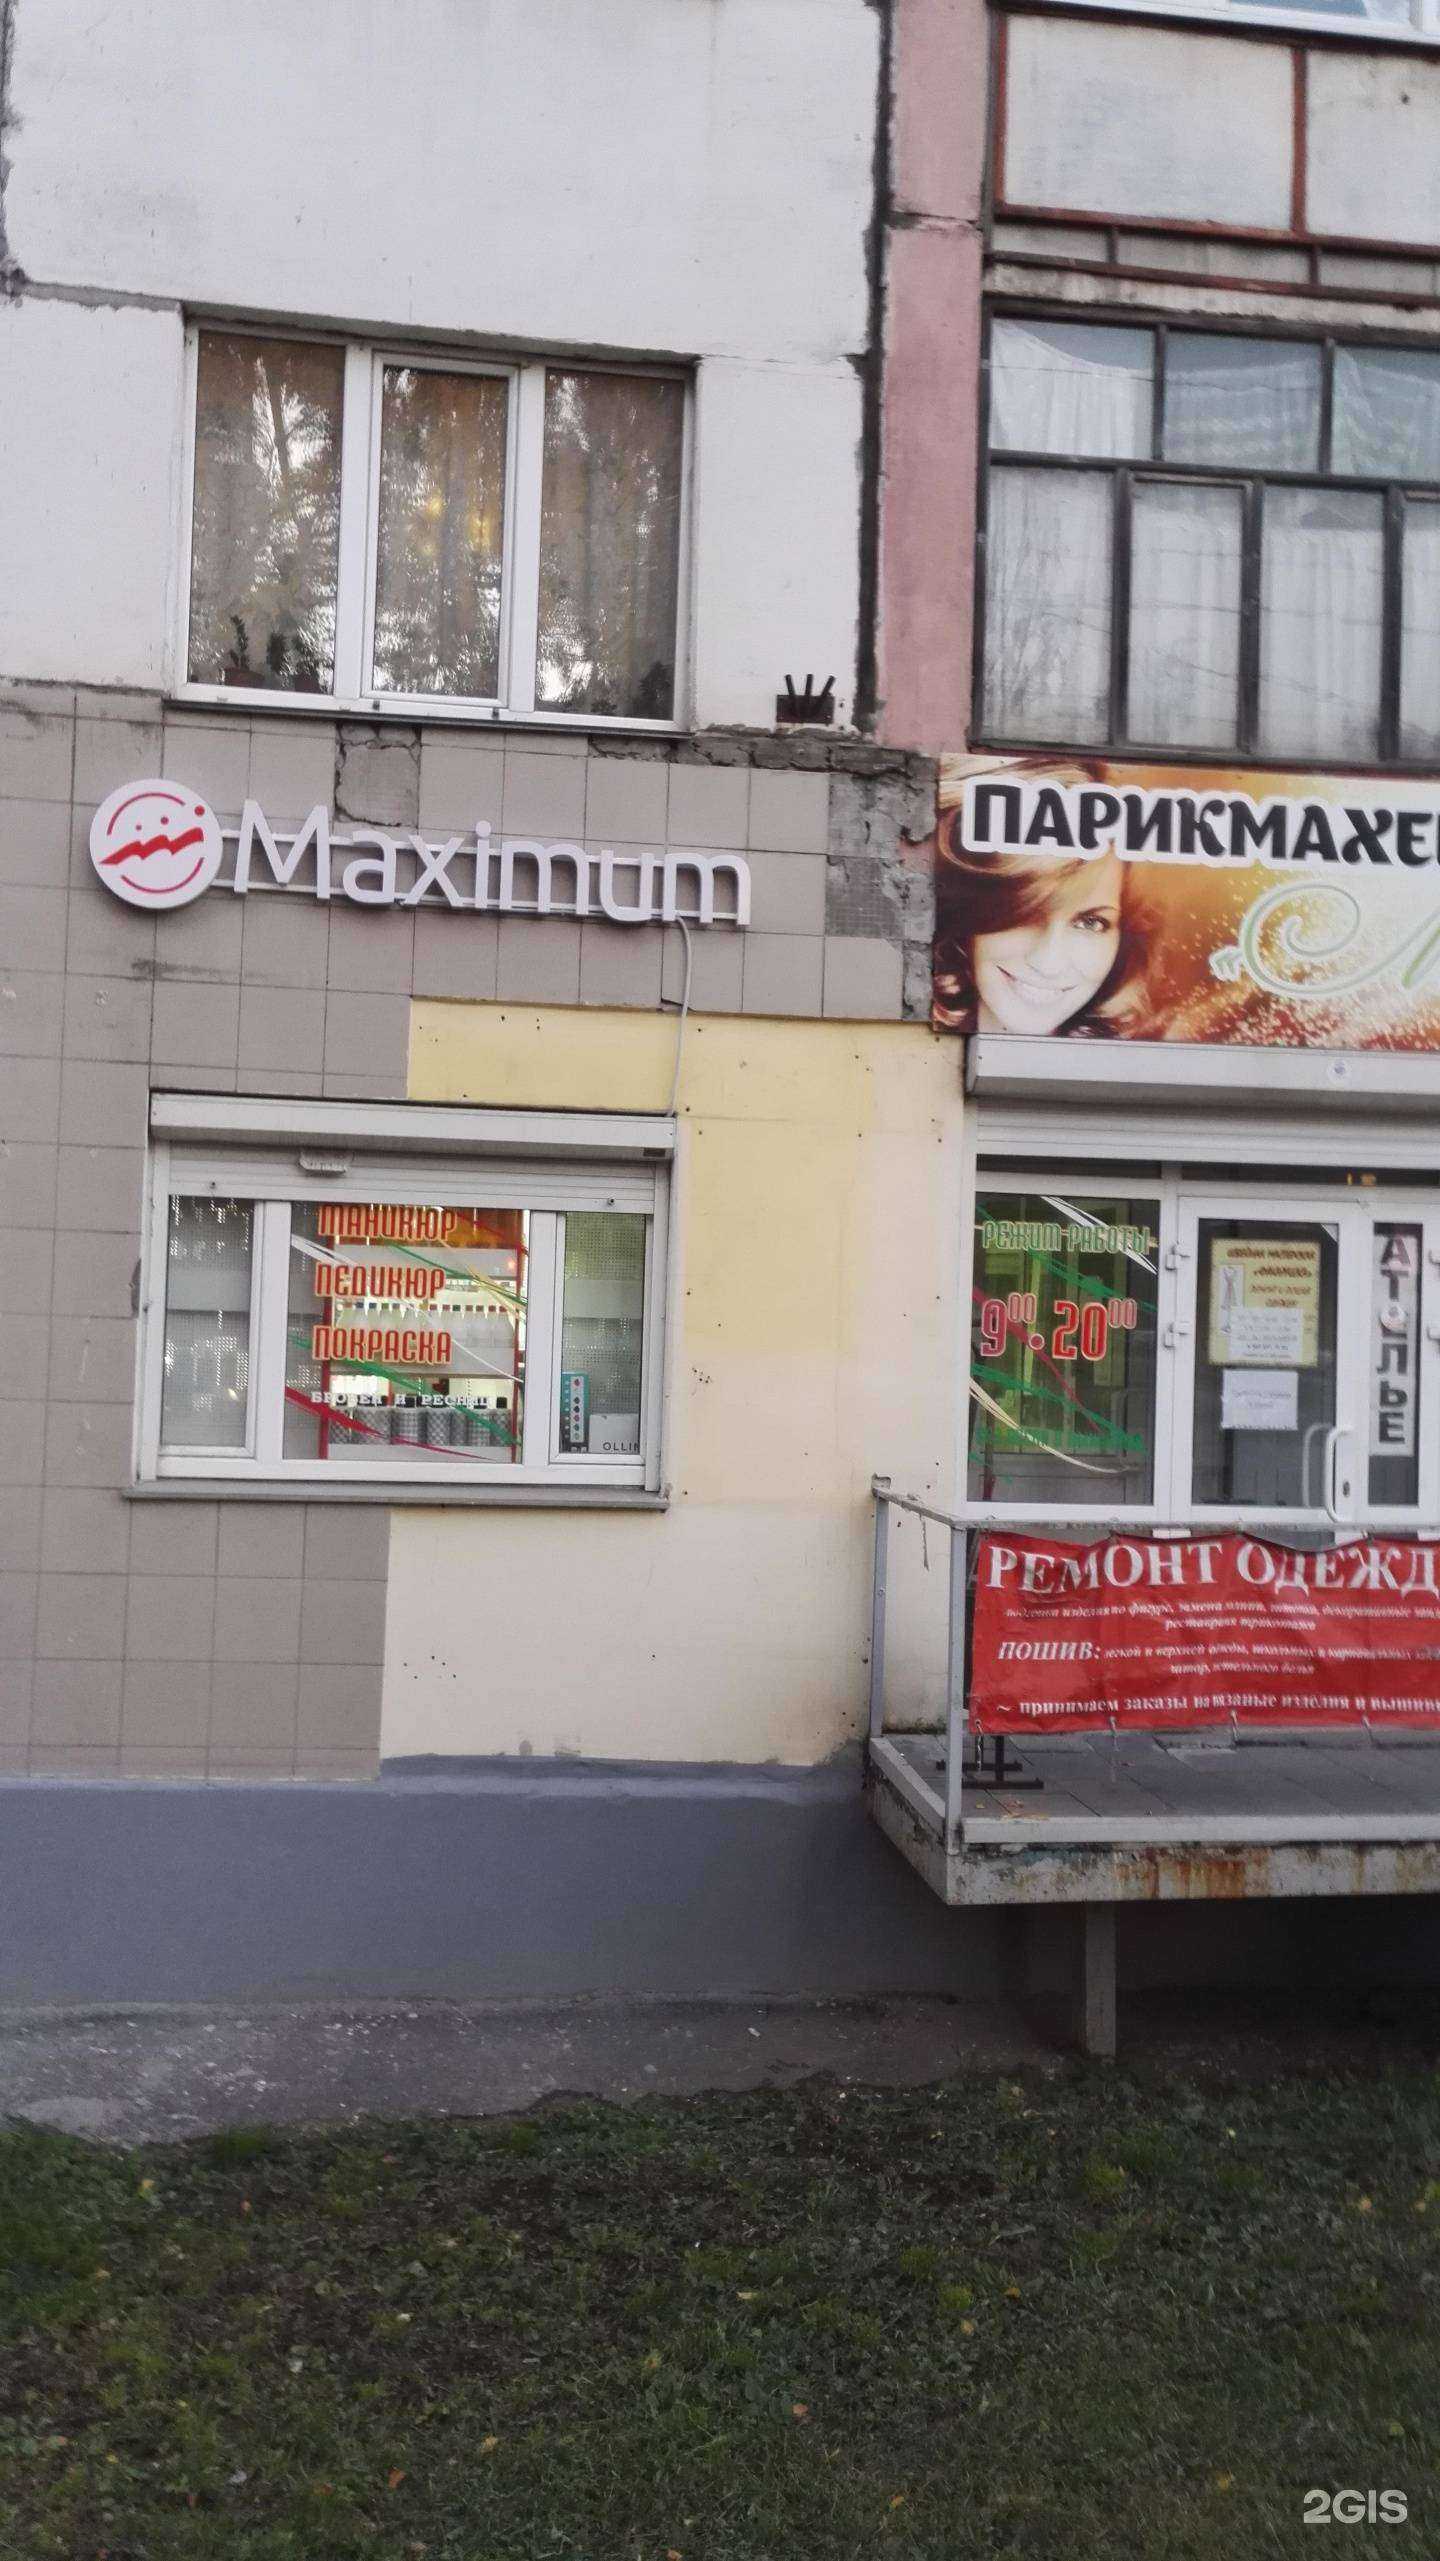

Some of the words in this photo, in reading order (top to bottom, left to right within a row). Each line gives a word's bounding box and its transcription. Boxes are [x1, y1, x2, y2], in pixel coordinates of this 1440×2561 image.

[974, 783, 1440, 869] ПАРИКМАХЕ
[233, 799, 752, 926] Maximum
[318, 1205, 457, 1240] МАНИКЮР
[983, 1220, 1062, 1251] РЕЖИМ
[1066, 1222, 1151, 1256] РАБОТЫ
[315, 1261, 446, 1300] ПЕДИКЮР
[312, 1325, 452, 1365] ПОКРАСКА
[985, 1543, 1223, 1594] РЕМОНТ
[1020, 1699, 1119, 1717] принимаем
[1124, 1695, 1188, 1710] заказы
